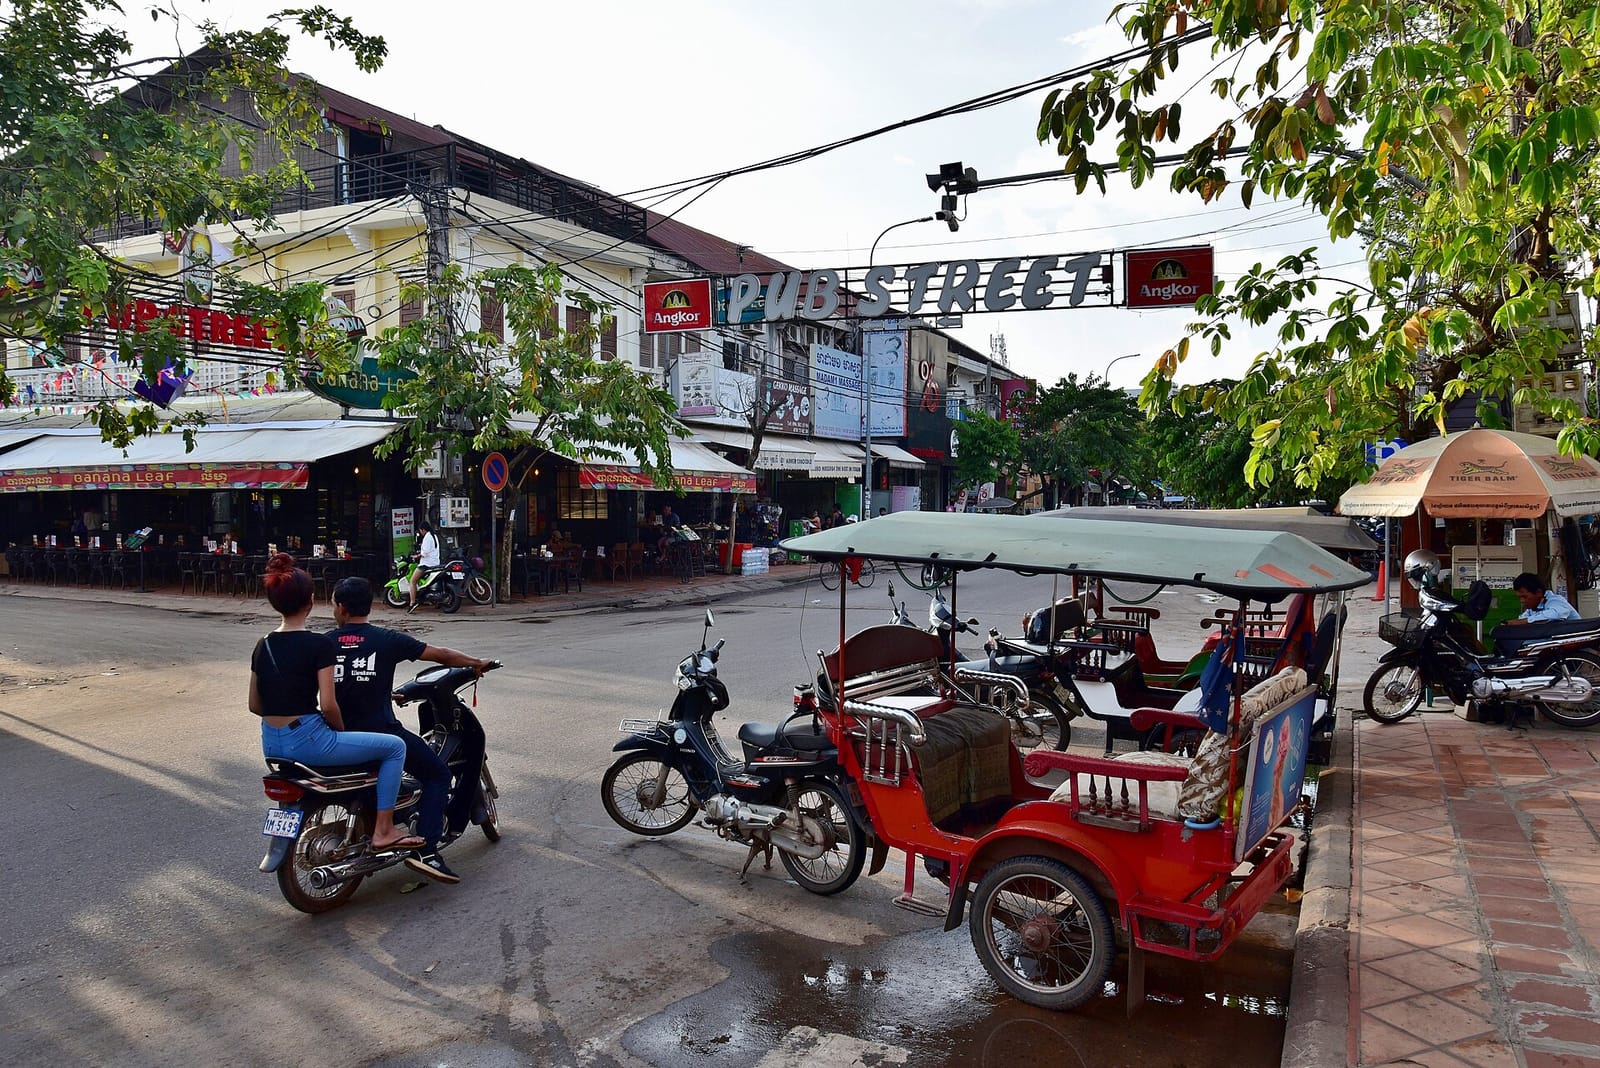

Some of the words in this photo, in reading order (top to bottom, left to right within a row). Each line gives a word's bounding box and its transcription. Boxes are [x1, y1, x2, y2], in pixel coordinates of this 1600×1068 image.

[728, 271, 840, 324] PUB
[856, 253, 1101, 317] STREET
[1140, 283, 1200, 300] Angkor
[654, 311, 700, 326] Angkor
